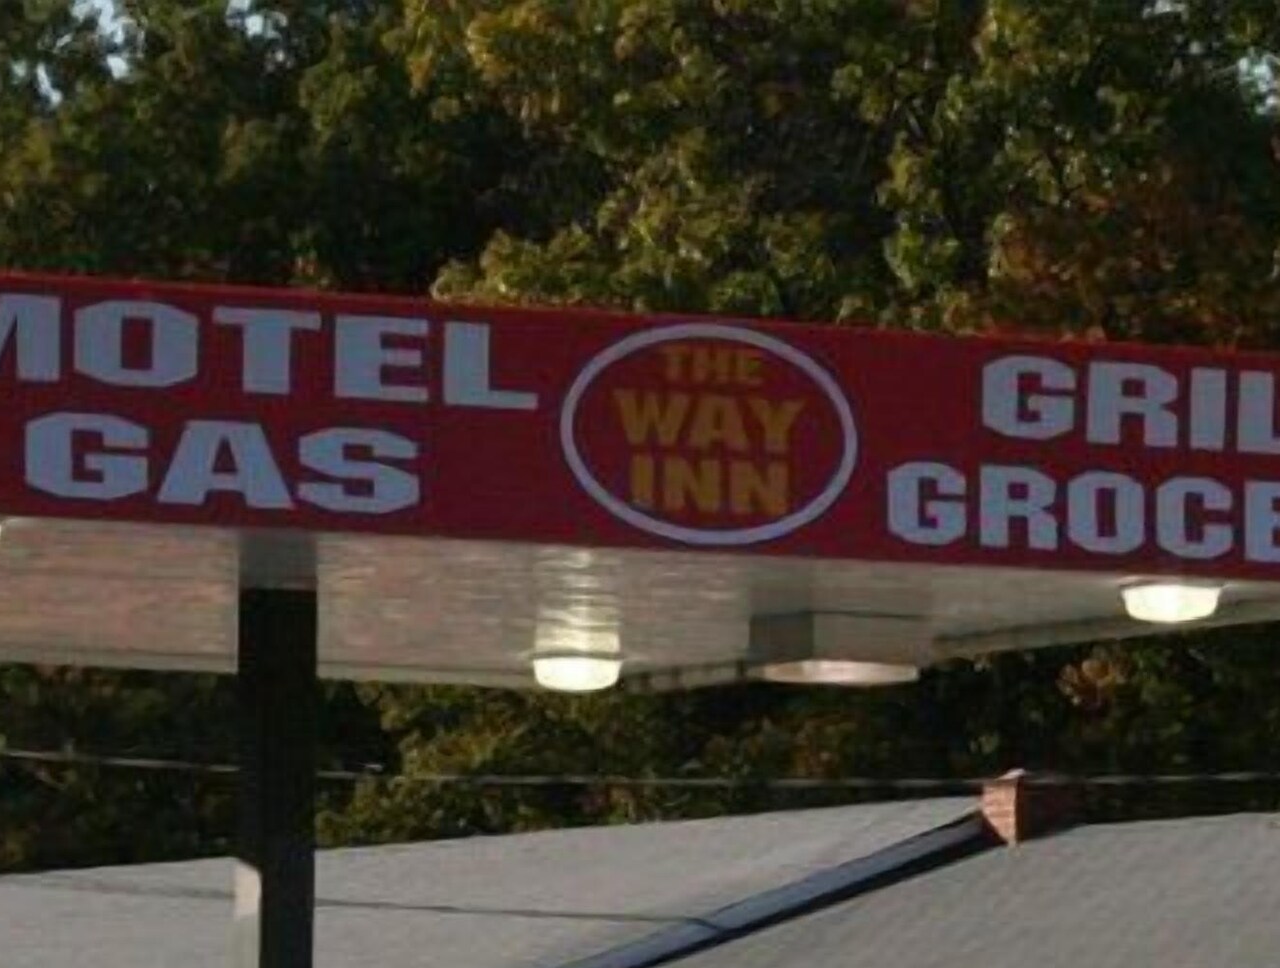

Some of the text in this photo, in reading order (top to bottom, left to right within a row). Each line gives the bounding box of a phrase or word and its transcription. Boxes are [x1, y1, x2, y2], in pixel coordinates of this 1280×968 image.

[664, 345, 764, 384] THE
[613, 388, 806, 454] WAY
[24, 411, 421, 515] GAS
[631, 454, 789, 515] INN
